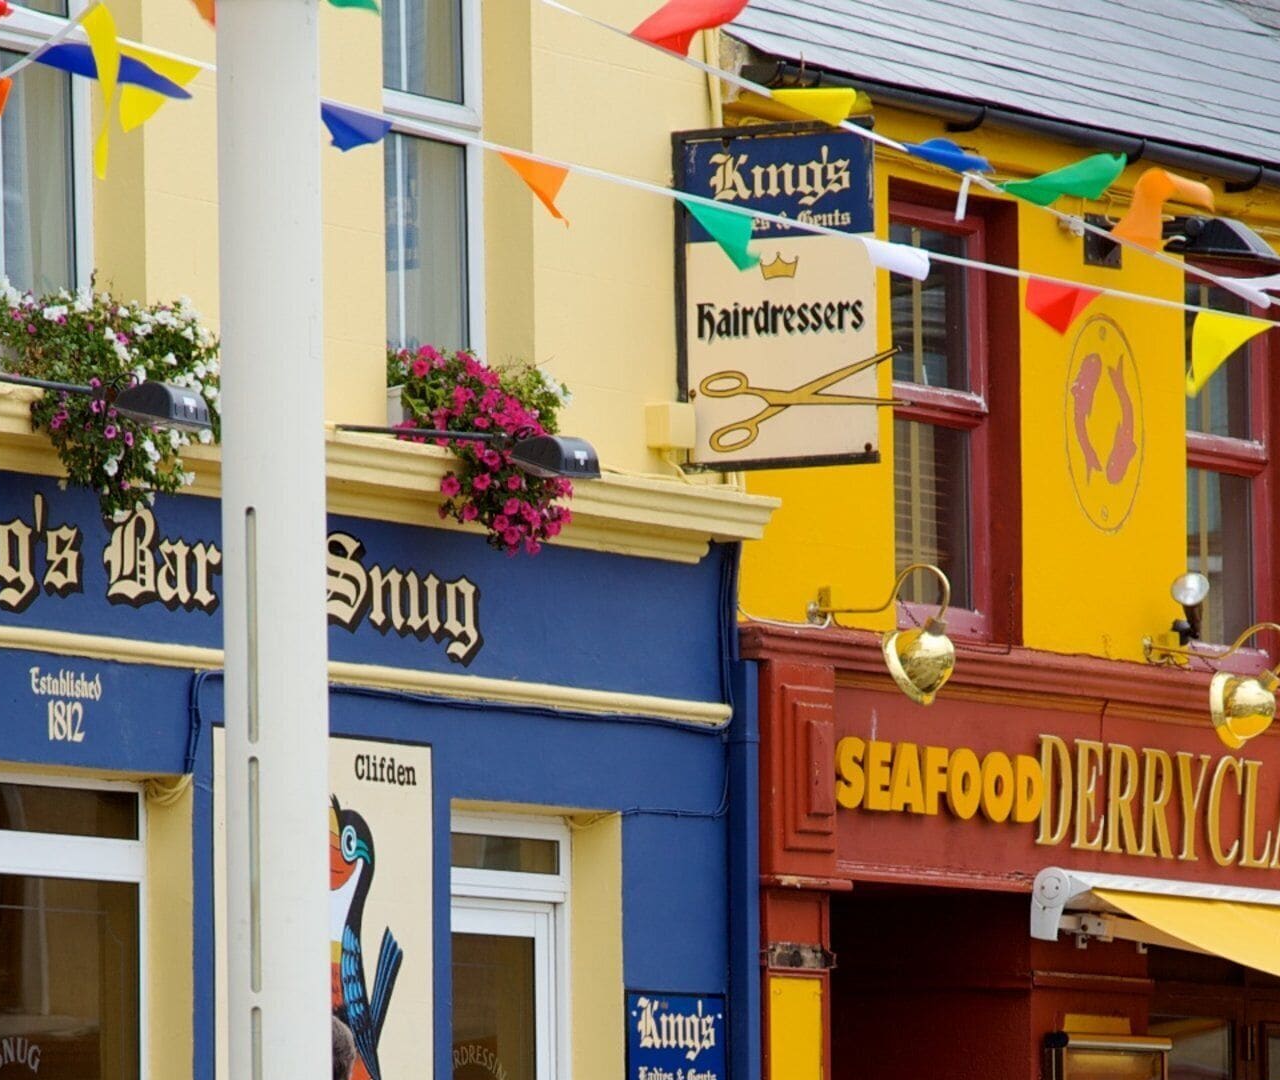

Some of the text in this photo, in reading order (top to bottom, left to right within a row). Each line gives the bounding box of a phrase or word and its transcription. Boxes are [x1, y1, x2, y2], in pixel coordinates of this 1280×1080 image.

[708, 145, 851, 207] King's
[102, 508, 222, 610] Bar
[327, 531, 478, 660] Snug
[29, 666, 102, 702] Established
[47, 699, 86, 742] 1812
[354, 753, 418, 787] Clifden
[835, 736, 1044, 825] SEAFOOD
[637, 996, 717, 1062] King's
